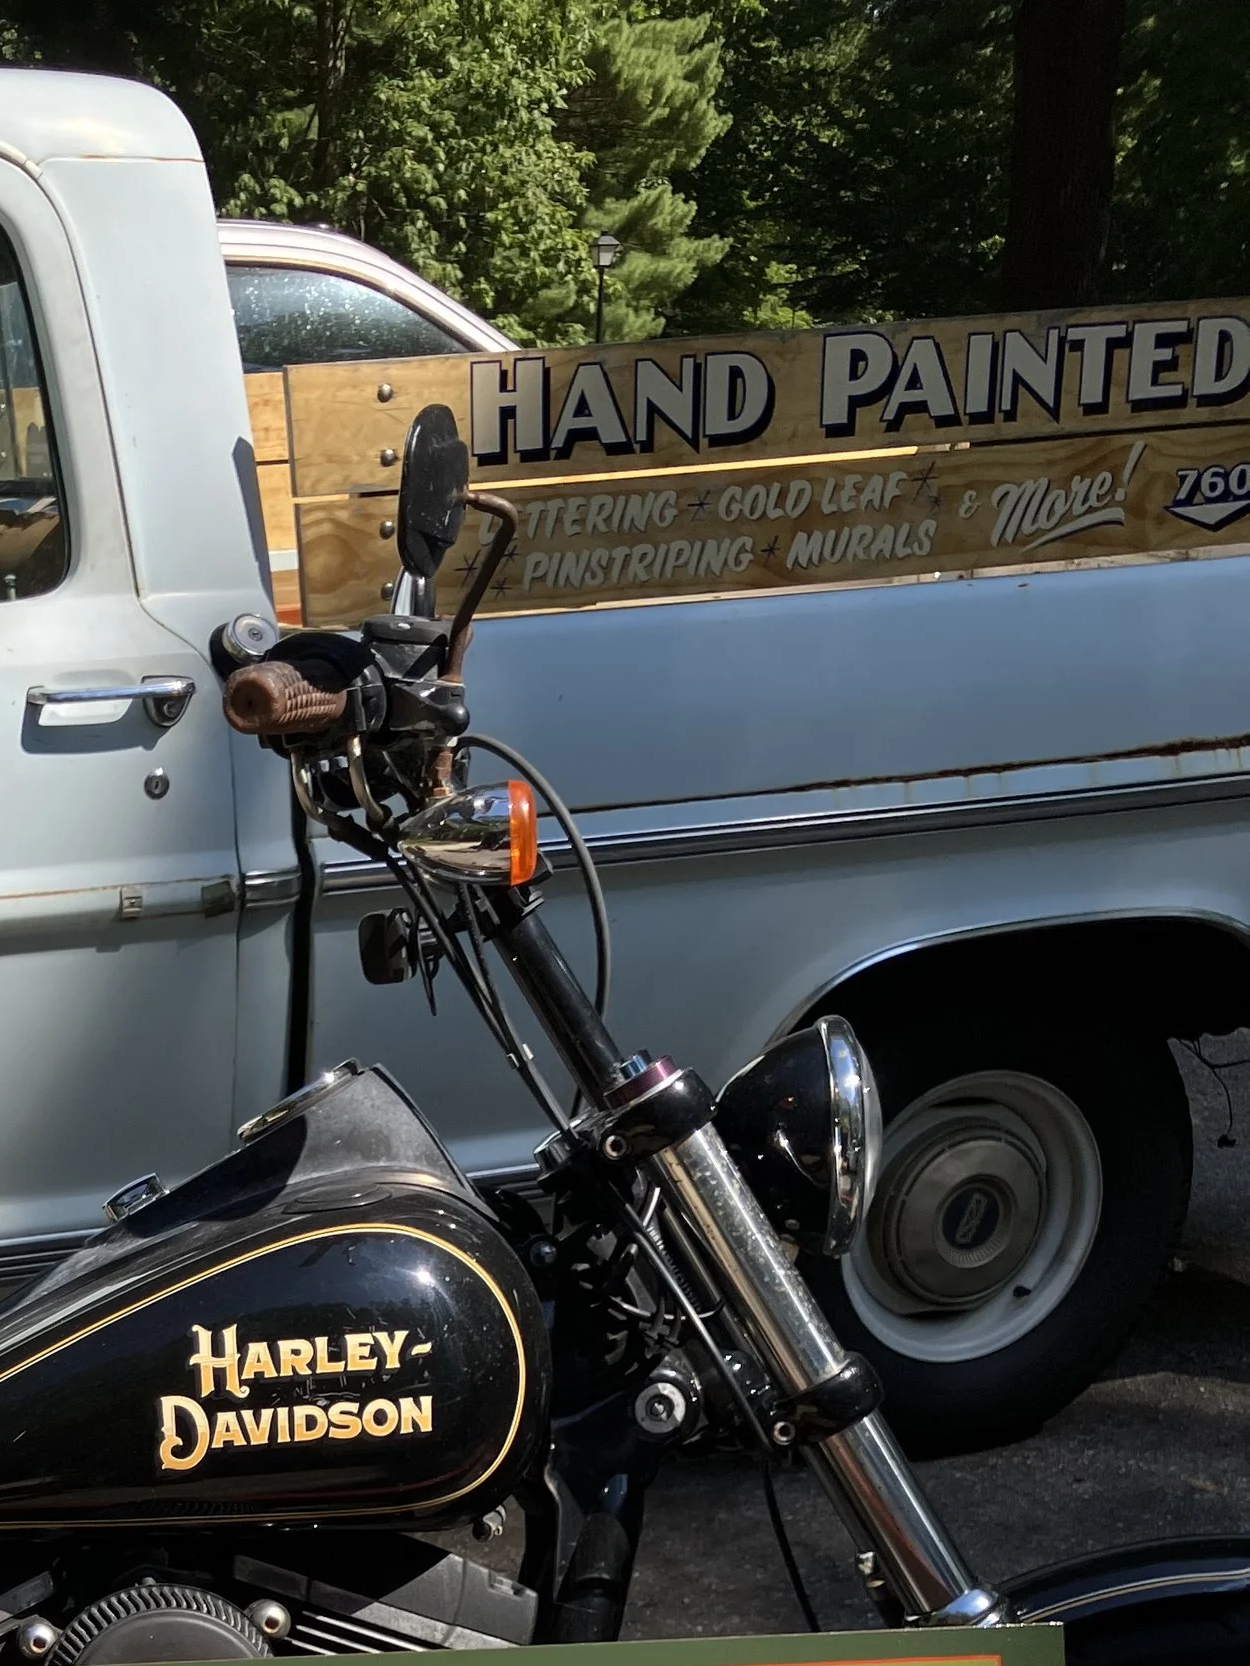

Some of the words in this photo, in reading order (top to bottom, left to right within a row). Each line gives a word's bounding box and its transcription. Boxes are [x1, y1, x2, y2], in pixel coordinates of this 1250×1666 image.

[470, 351, 776, 467] HAND
[821, 315, 1250, 437] PAINTED
[478, 490, 678, 546] LTTERING
[717, 479, 812, 522] GOLD
[819, 471, 908, 516] LEAF
[958, 490, 983, 519] &
[989, 440, 1147, 548] More!
[523, 536, 754, 592] PINSTRIPING
[786, 519, 938, 570] MURALS
[188, 1323, 433, 1398] HARLEY-
[159, 1396, 433, 1470] DAVIDSON
